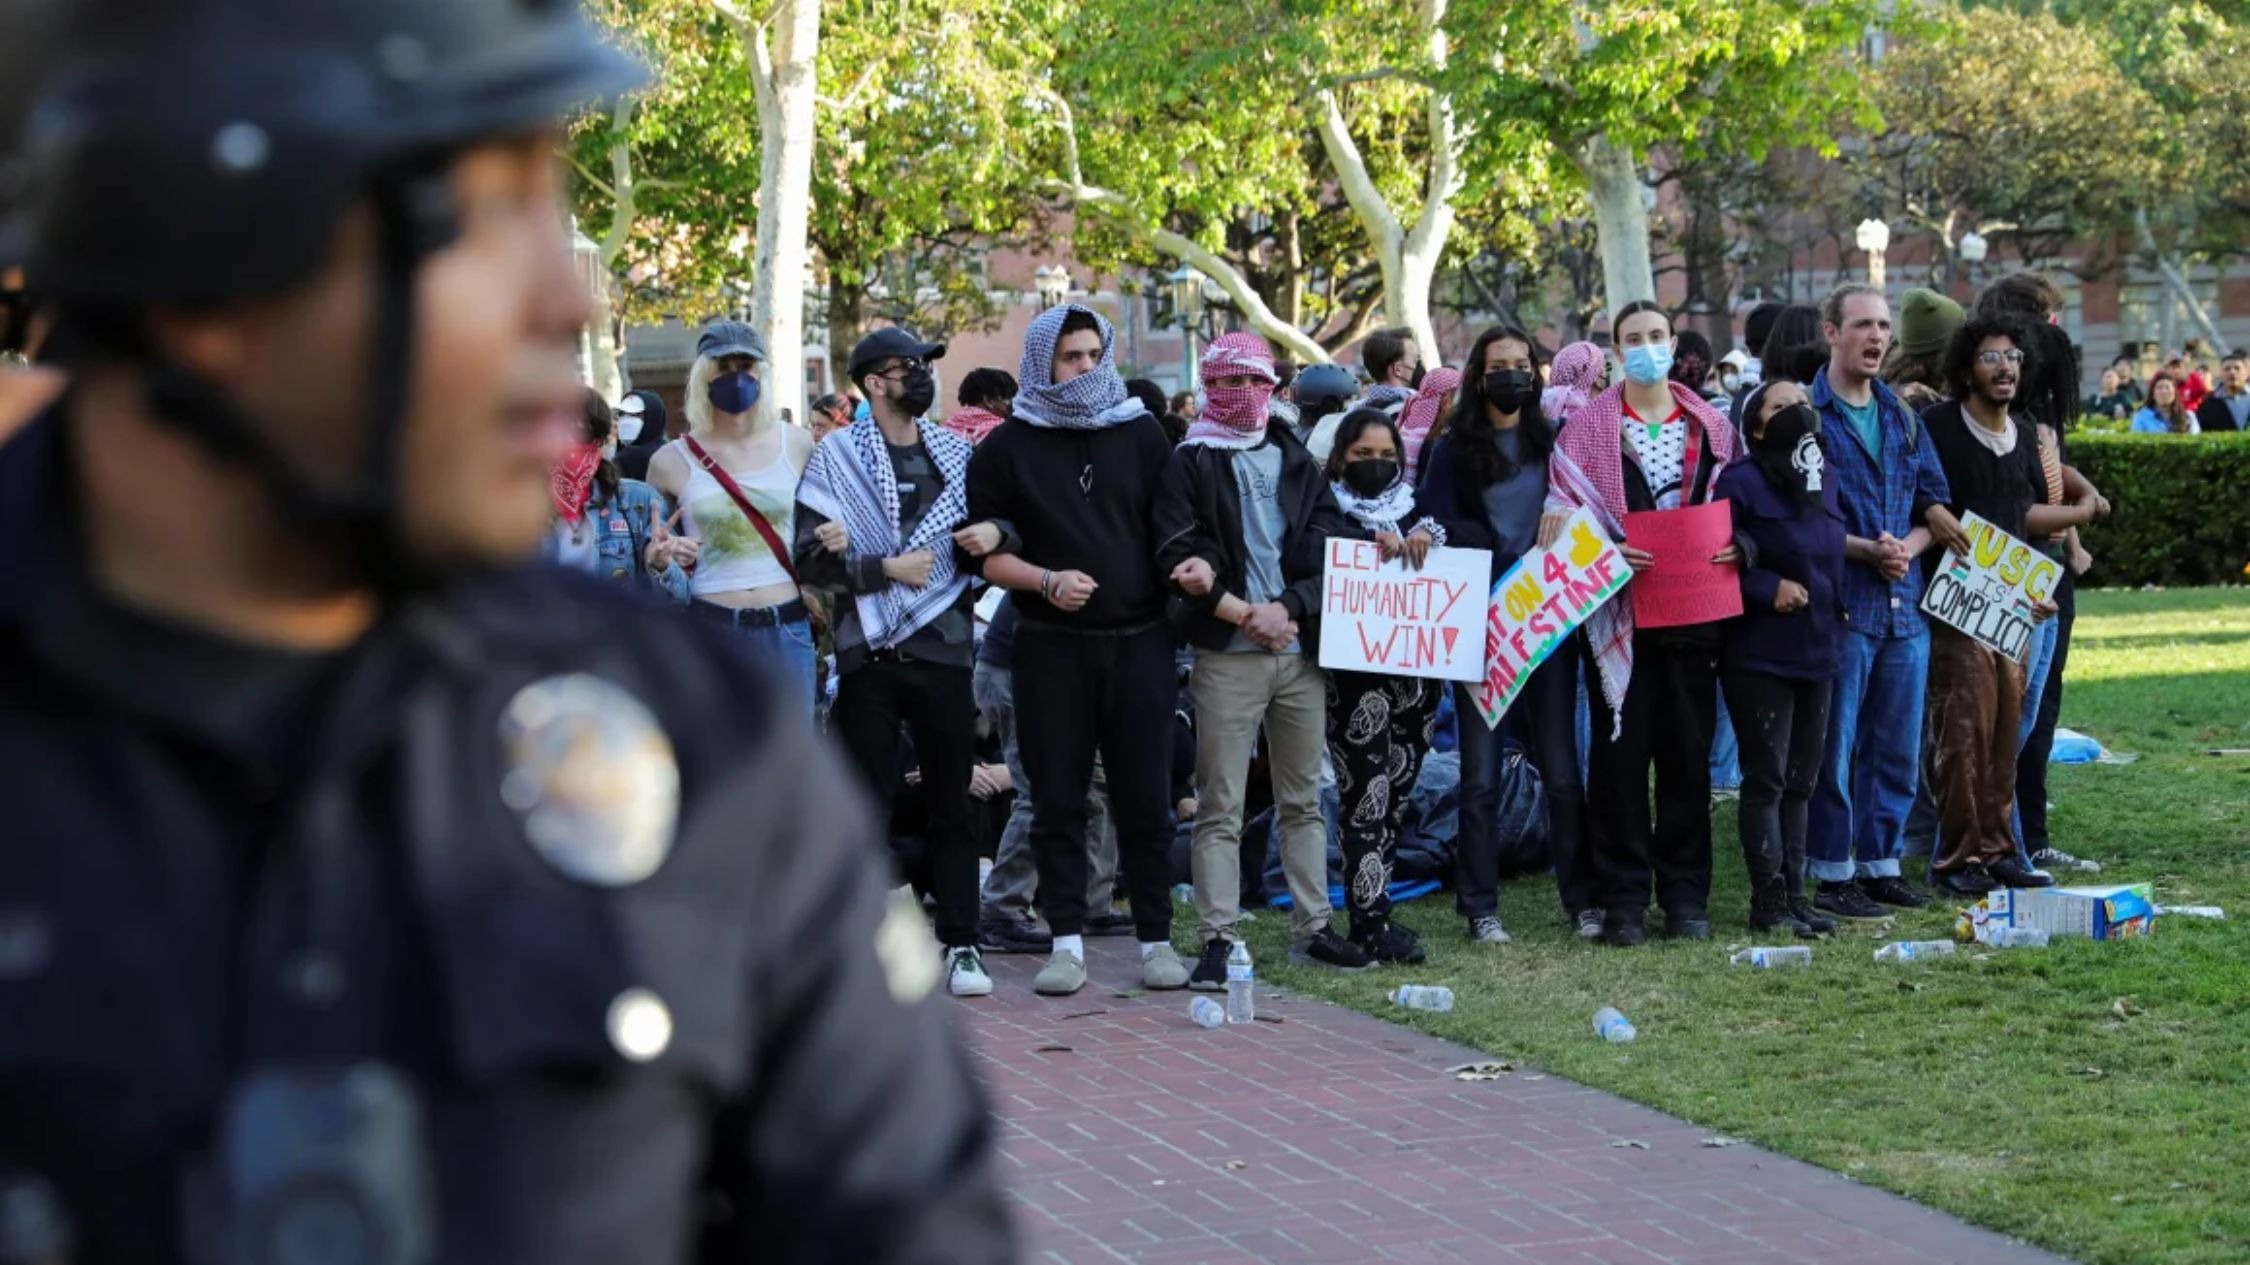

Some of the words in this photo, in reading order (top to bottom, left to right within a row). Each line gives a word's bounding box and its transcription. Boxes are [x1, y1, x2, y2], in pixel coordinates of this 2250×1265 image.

[1332, 541, 1384, 572] LET
[1328, 575, 1468, 623] HUMANITY
[1504, 572, 1545, 622] ON
[1543, 551, 1570, 587] 4
[1976, 575, 2007, 604] IS
[1479, 549, 1630, 722] PALESTINE
[1925, 573, 2034, 661] COMPLICIT
[1356, 621, 1460, 669] WIN!
